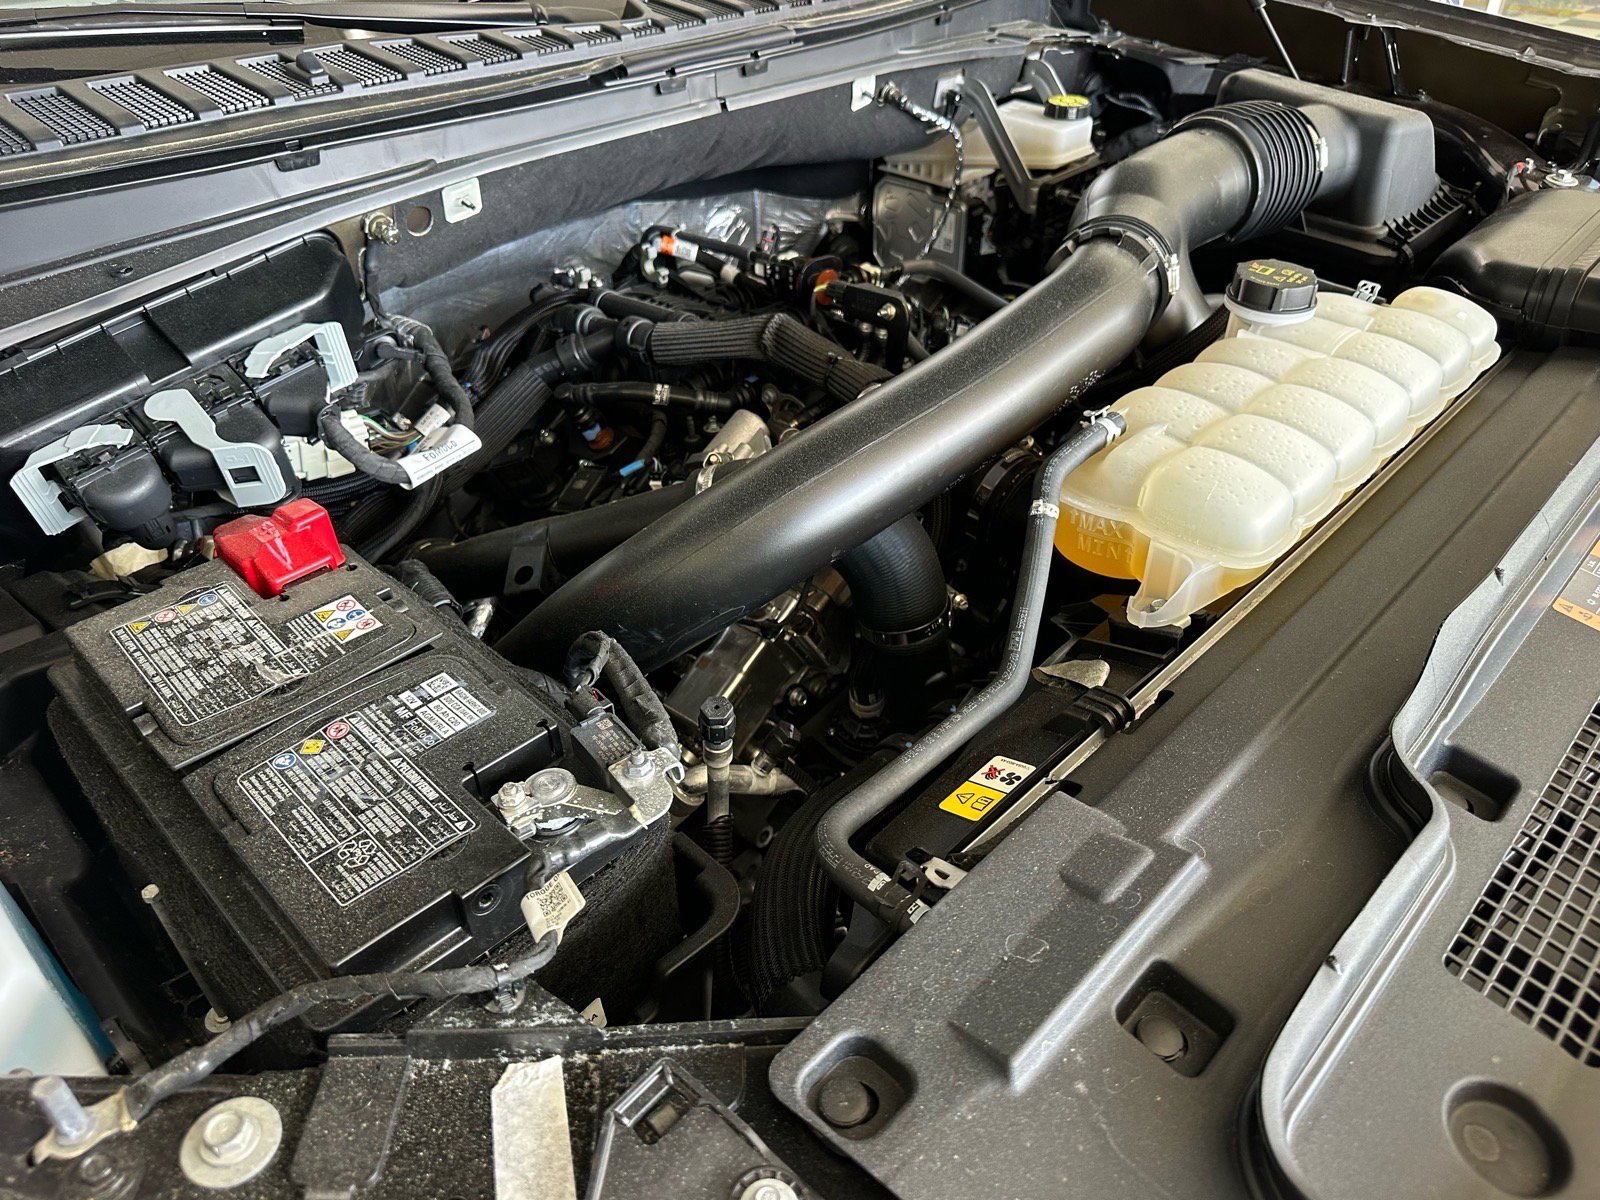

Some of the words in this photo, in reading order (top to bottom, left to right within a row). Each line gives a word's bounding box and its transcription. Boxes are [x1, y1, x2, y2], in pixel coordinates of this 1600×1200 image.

[422, 440, 458, 461] FoMoCo
[1078, 513, 1124, 539] MAX
[404, 694, 416, 705] 12V
[394, 705, 413, 720] MF
[439, 709, 452, 718] Ah
[419, 710, 450, 735] AGM/VRLA
[408, 720, 436, 746] FoMoCo
[525, 884, 553, 900] TORQUE
